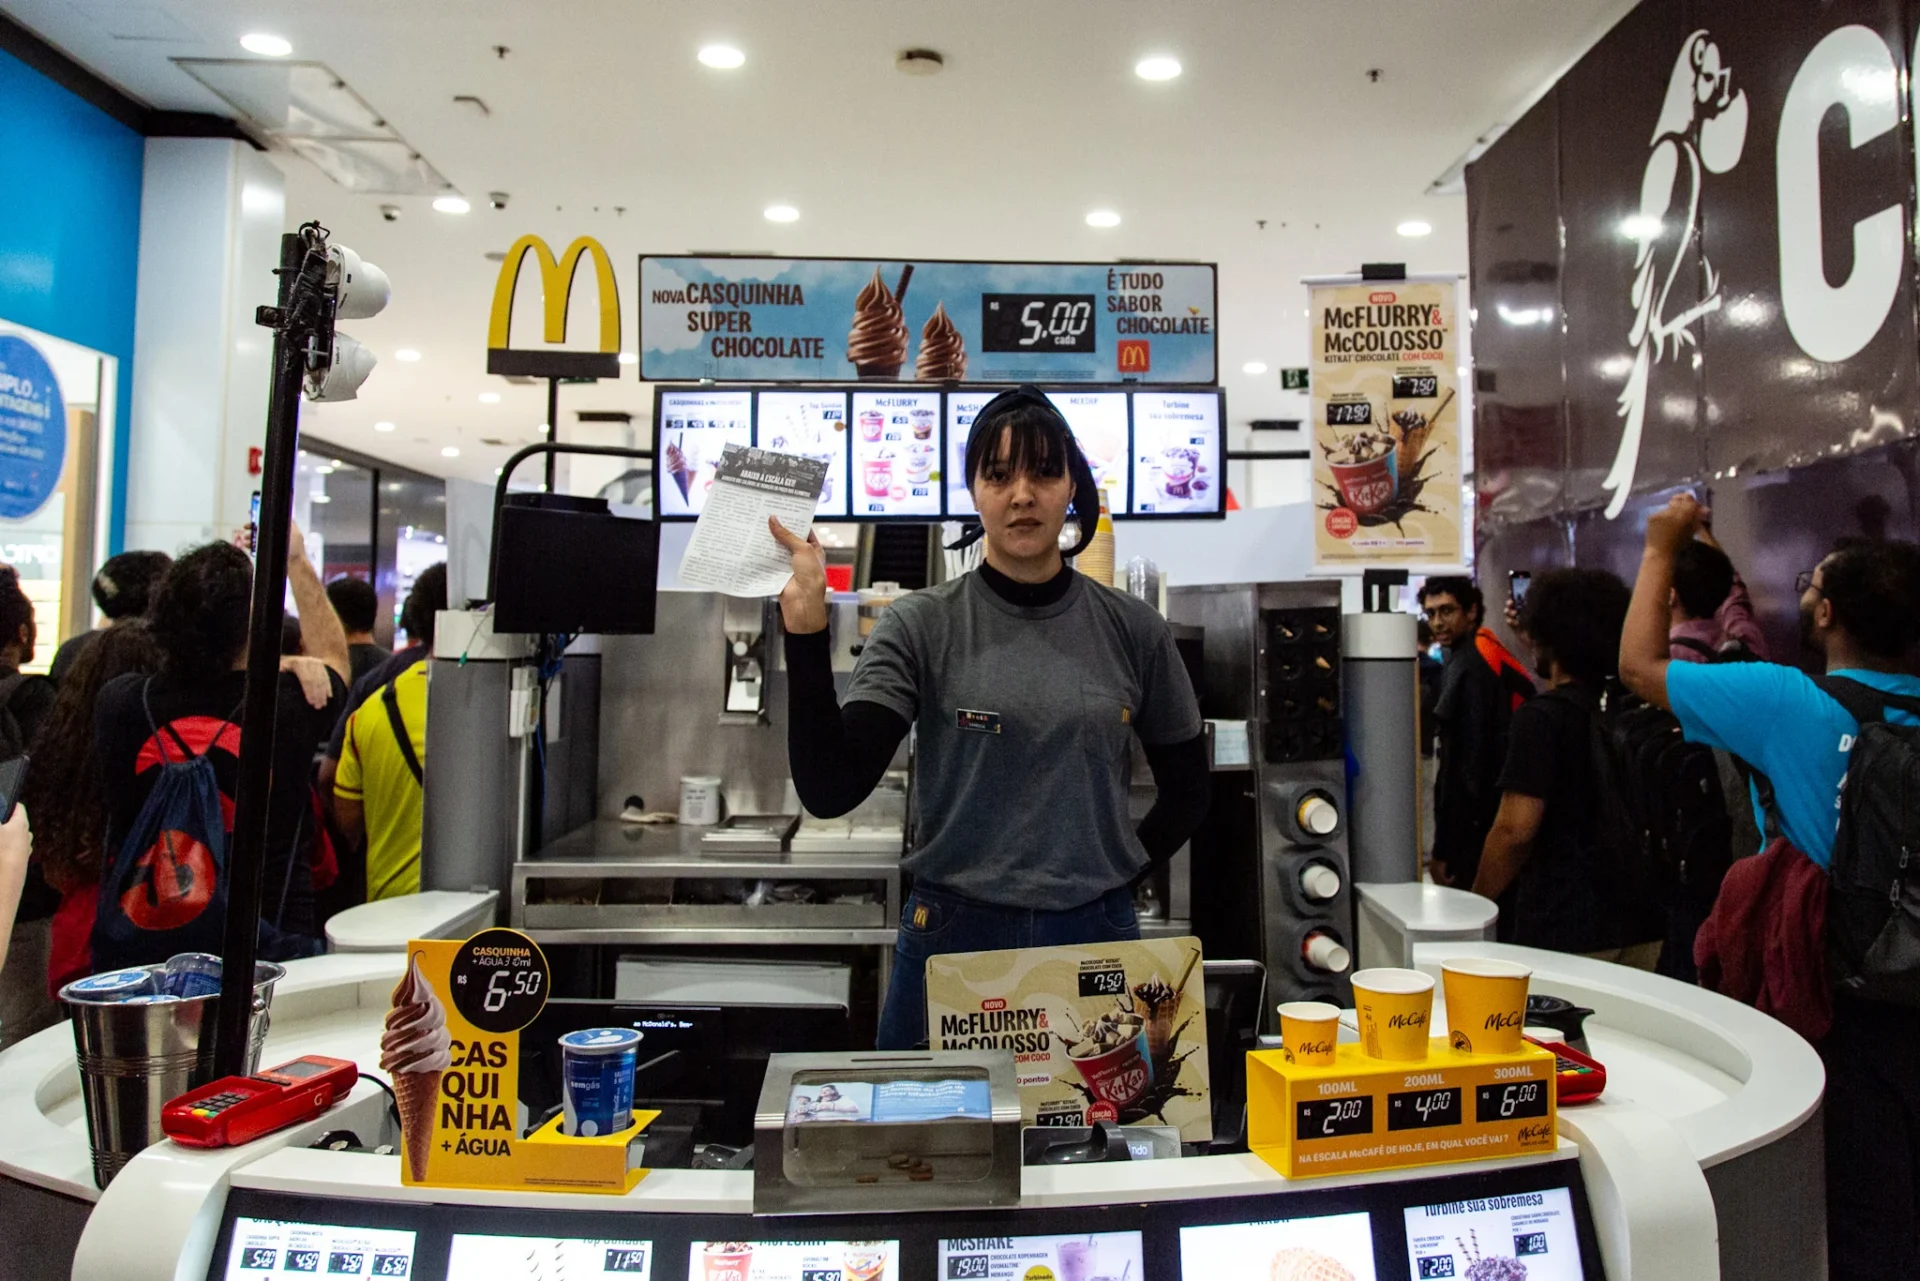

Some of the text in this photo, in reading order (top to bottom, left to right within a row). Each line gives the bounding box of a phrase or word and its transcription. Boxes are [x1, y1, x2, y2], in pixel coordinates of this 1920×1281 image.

[1107, 268, 1164, 290] É TUDO
[652, 282, 804, 309] NOVA CASQUINHA
[1107, 295, 1163, 313] SABOR
[687, 310, 752, 332] SUPER
[1116, 317, 1210, 335] CHOCOLATE
[711, 337, 825, 359] CHOCOLATE
[1054, 335, 1076, 345] cada
[1355, 352, 1400, 363] CHOCOLATE
[1402, 352, 1421, 361] COM
[1422, 351, 1444, 361] COCO
[472, 947, 531, 958] CASQUINHA
[478, 956, 504, 966] ÁGUA
[457, 974, 467, 985] R$
[984, 1000, 1004, 1009] NOVO
[451, 1041, 507, 1068] CAS
[1031, 1053, 1051, 1062] COCO
[1023, 1076, 1050, 1085] pontos
[1404, 1073, 1445, 1088] 200ML
[1494, 1065, 1534, 1080] 300ML
[441, 1072, 499, 1104] QUI
[1317, 1081, 1358, 1095] 100ML
[441, 1103, 512, 1131] NHA
[1518, 1123, 1551, 1141] McCafé
[441, 1132, 512, 1157] + ÁGUA
[1299, 1154, 1312, 1164] NA
[1313, 1151, 1348, 1162] ESCALA
[1349, 1146, 1384, 1159] McCAFÉ
[1386, 1145, 1398, 1155] DE
[1399, 1143, 1425, 1154] HOJE,
[1426, 1141, 1439, 1151] EM
[1440, 1139, 1463, 1150] QUAL
[1465, 1135, 1487, 1147] VOCÊ
[1467, 1198, 1486, 1213] sua
[1488, 1193, 1544, 1211] sobremesa
